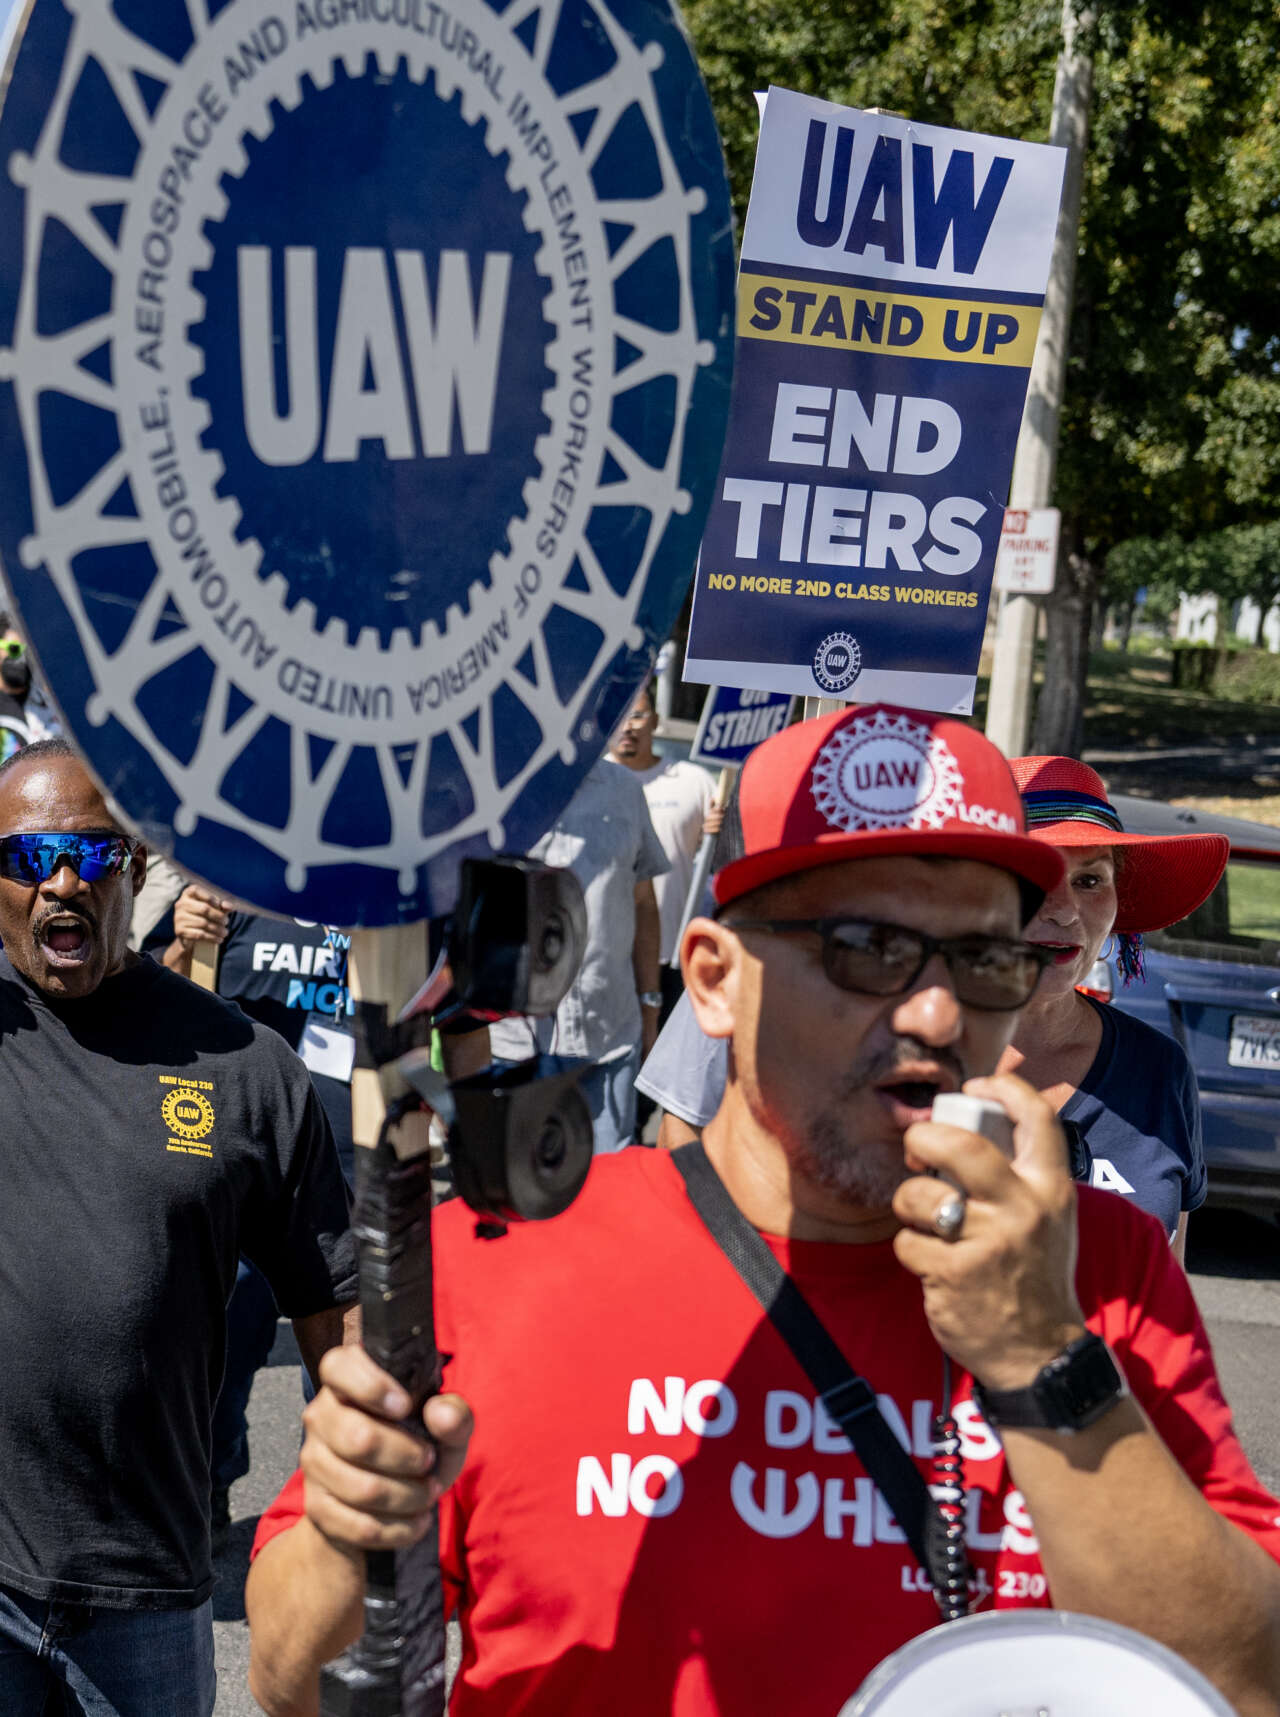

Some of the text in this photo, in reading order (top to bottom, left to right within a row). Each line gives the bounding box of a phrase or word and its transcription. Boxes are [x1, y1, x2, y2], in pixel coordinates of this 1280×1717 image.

[797, 118, 1015, 275] UAW
[750, 286, 1020, 355] STAND UP
[136, 0, 594, 720] UNITED AUTOMOBILE, AEROSPACE AND AGRICULTURAL IMPLEMENT WORKERS OF AMERICA
[238, 246, 513, 466] UAW
[768, 382, 962, 476] END
[723, 477, 988, 576] TIERS
[708, 573, 979, 609] NO MORE 2ND CLASS WORKERS
[826, 654, 848, 668] UAW
[703, 702, 788, 752] STRIKE
[853, 760, 920, 791] UAW
[252, 941, 340, 979] FAIR
[178, 1077, 198, 1088] Local
[199, 1080, 214, 1091] 230
[176, 1106, 200, 1120] UAW
[628, 1376, 738, 1438] NO
[576, 1452, 684, 1518] NO
[997, 1569, 1047, 1599] 230
